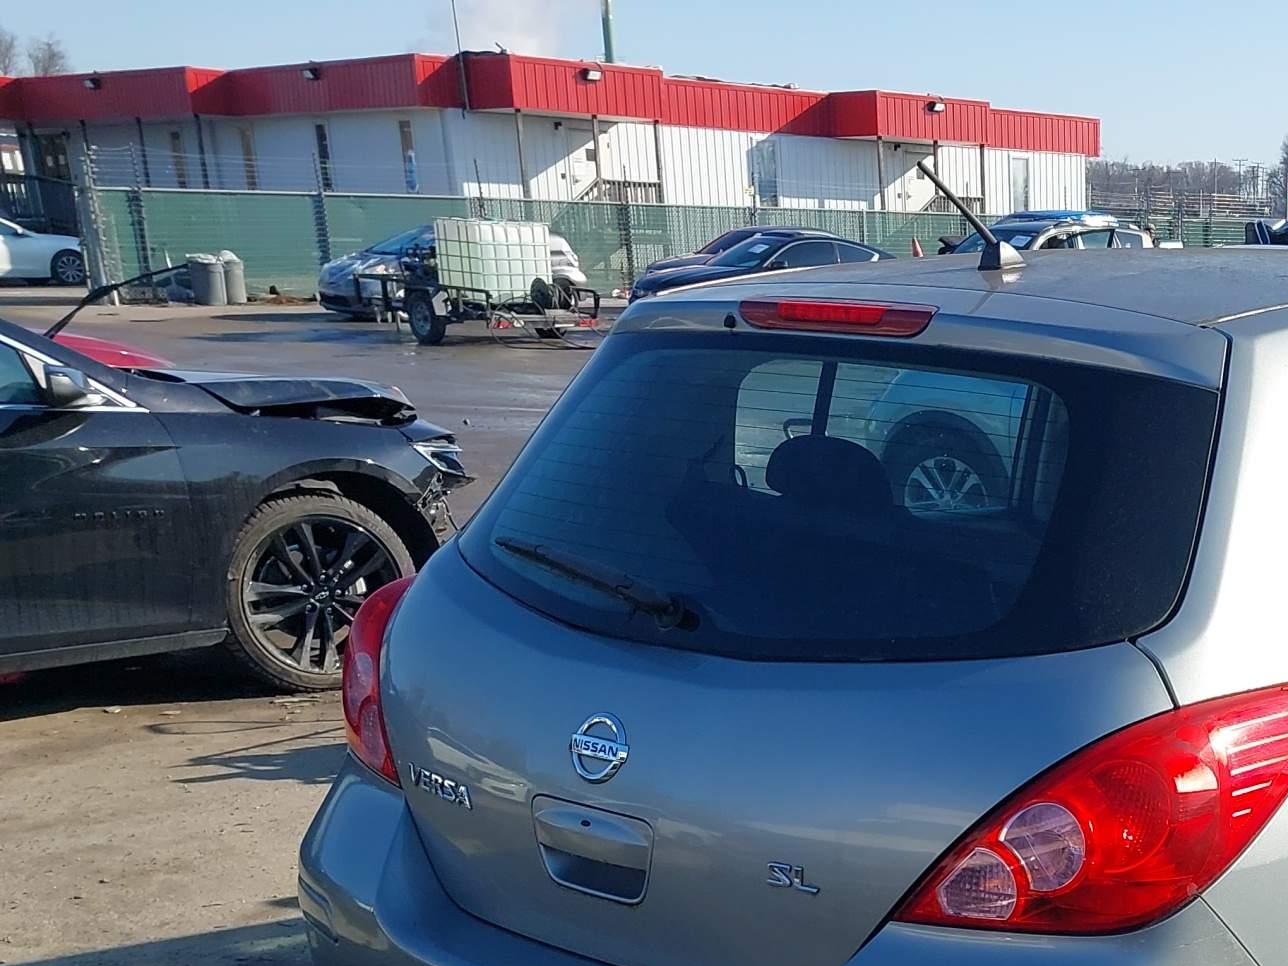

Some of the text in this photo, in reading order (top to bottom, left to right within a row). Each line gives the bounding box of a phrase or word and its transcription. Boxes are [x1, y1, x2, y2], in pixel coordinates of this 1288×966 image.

[573, 738, 619, 758] NISSAN
[408, 761, 472, 810] VERSA
[767, 861, 820, 895] SL
